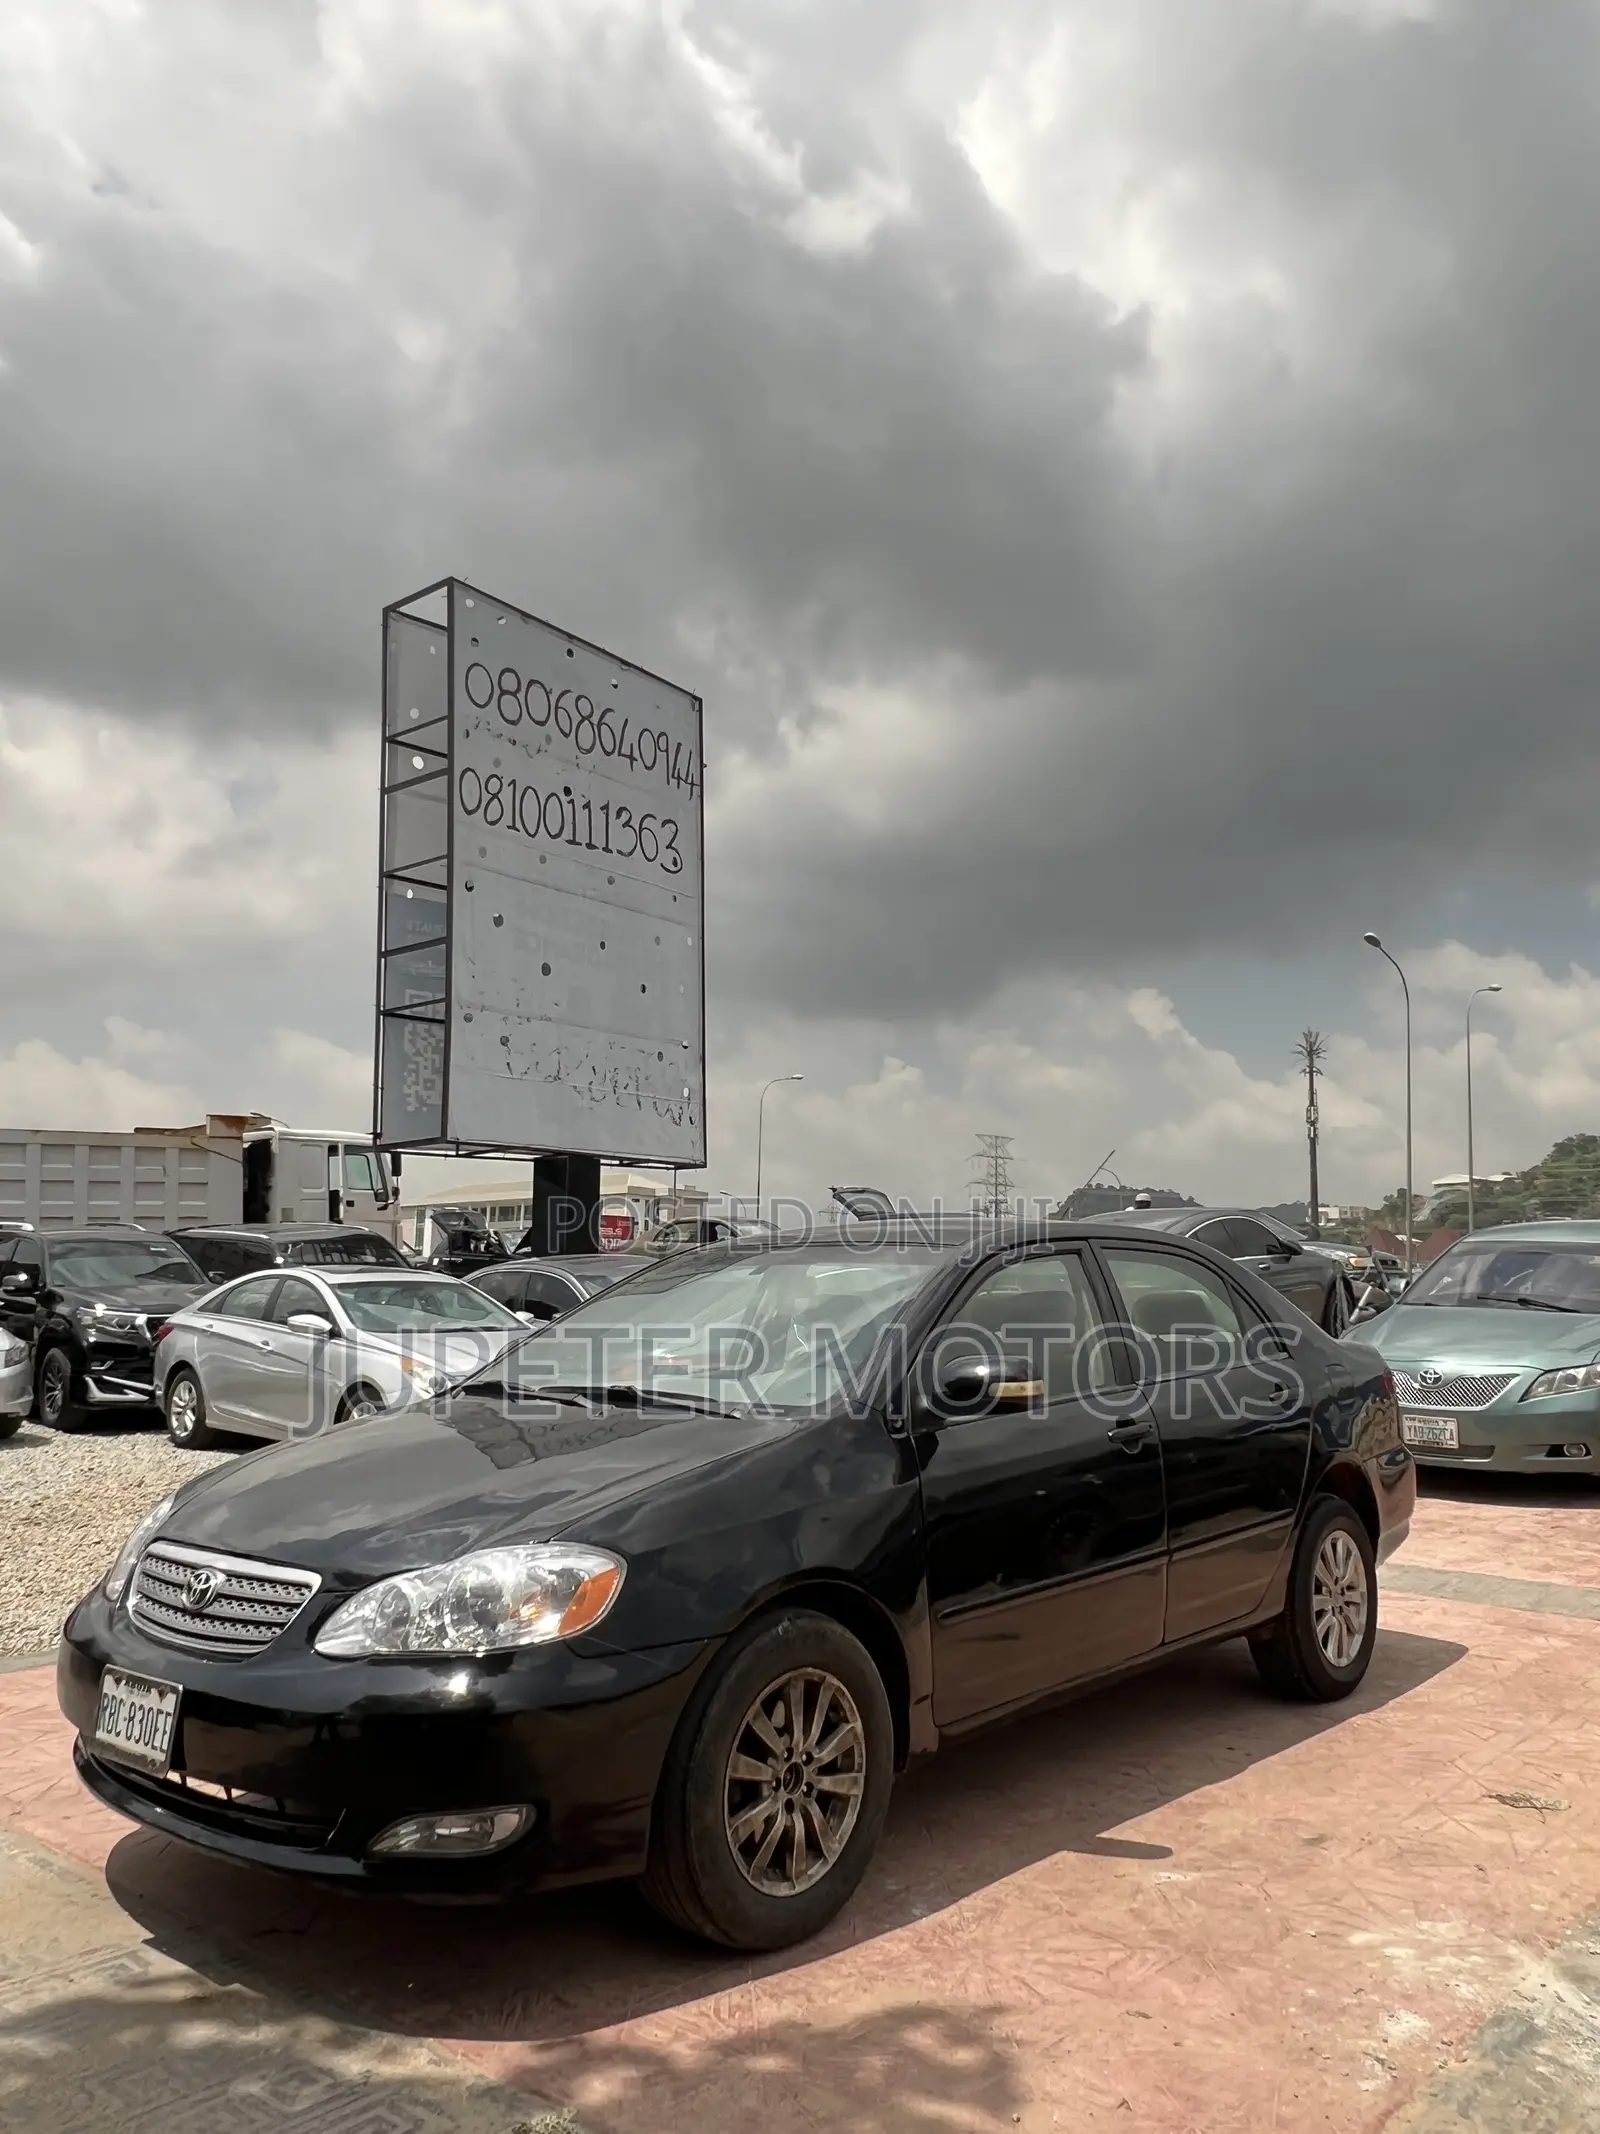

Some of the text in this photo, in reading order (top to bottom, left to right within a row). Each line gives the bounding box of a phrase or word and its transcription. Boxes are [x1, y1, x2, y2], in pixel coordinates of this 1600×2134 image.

[465, 662, 700, 800] 08068640944
[459, 767, 683, 874] 08100111363
[98, 1692, 173, 1753] RBC-830EE
